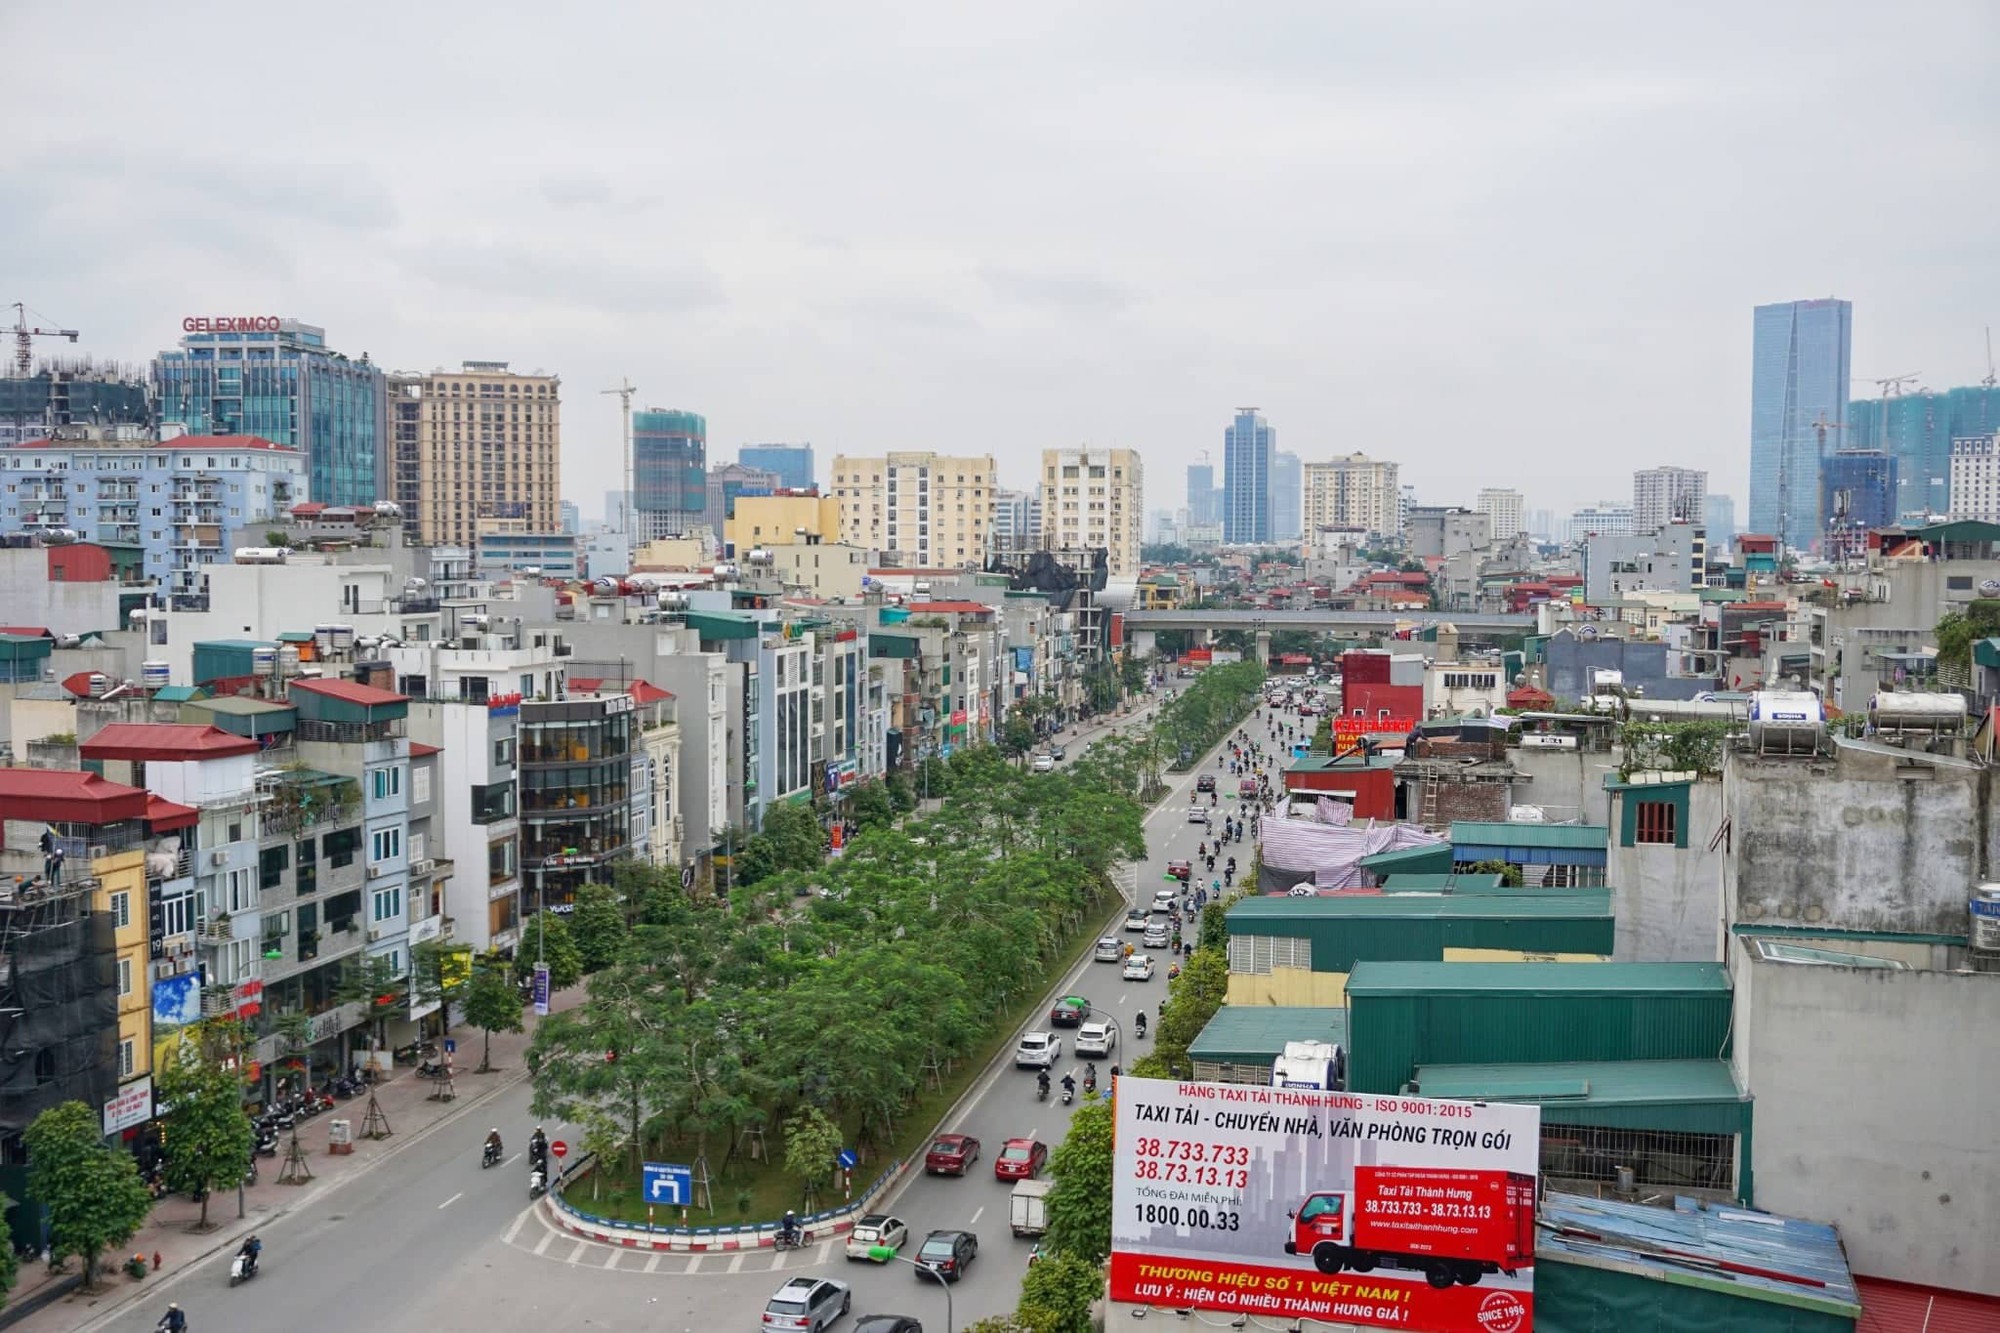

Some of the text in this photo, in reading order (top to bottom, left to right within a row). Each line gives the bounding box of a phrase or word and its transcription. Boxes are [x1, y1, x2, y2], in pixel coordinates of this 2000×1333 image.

[183, 316, 280, 332] GELEXIMCO
[1179, 1083, 1215, 1099] HÃNG
[1219, 1088, 1248, 1102] TAXI
[1250, 1089, 1271, 1103] TẢI
[1274, 1090, 1320, 1107] THÀNH
[1324, 1096, 1363, 1110] HƯNG
[1376, 1099, 1398, 1112] ISO
[1135, 1104, 1171, 1123] TAXI
[1175, 1103, 1200, 1126] TẢI
[1215, 1110, 1280, 1133] CHUYỂN
[1283, 1114, 1323, 1139] NHÀ,
[1330, 1117, 1363, 1139] VĂN
[1367, 1121, 1426, 1144] PHÒNG
[1431, 1128, 1478, 1150] TRỌN
[1482, 1129, 1512, 1150] GÓI
[1135, 1137, 1249, 1166] 38.733.733
[1134, 1160, 1248, 1188] 38.73.13.13
[1136, 1186, 1167, 1199] TỔNG
[1169, 1190, 1188, 1201] ĐÀI
[1378, 1185, 1397, 1196] Taxi
[1446, 1188, 1473, 1201] Hưng
[1135, 1203, 1240, 1232] 1800.00.33
[1365, 1200, 1421, 1215] 38.733.733
[1431, 1204, 1491, 1218] 38.73.13.13
[1370, 1219, 1478, 1235] www.taxitaithanhhung.com
[1138, 1264, 1411, 1302] THƯƠNG HIỆU SỐ 1 VIỆT NAM !
[1134, 1283, 1162, 1296] LƯU
[1164, 1283, 1173, 1298] Ý
[1183, 1287, 1215, 1302] HIỆN
[1218, 1289, 1237, 1304] CÓ
[1239, 1292, 1280, 1308] NHIỀU
[1283, 1296, 1330, 1313] THÀNH
[1333, 1303, 1372, 1317] HƯNG
[1403, 1309, 1409, 1322] !
[1477, 1304, 1525, 1324] SINCE 1996
